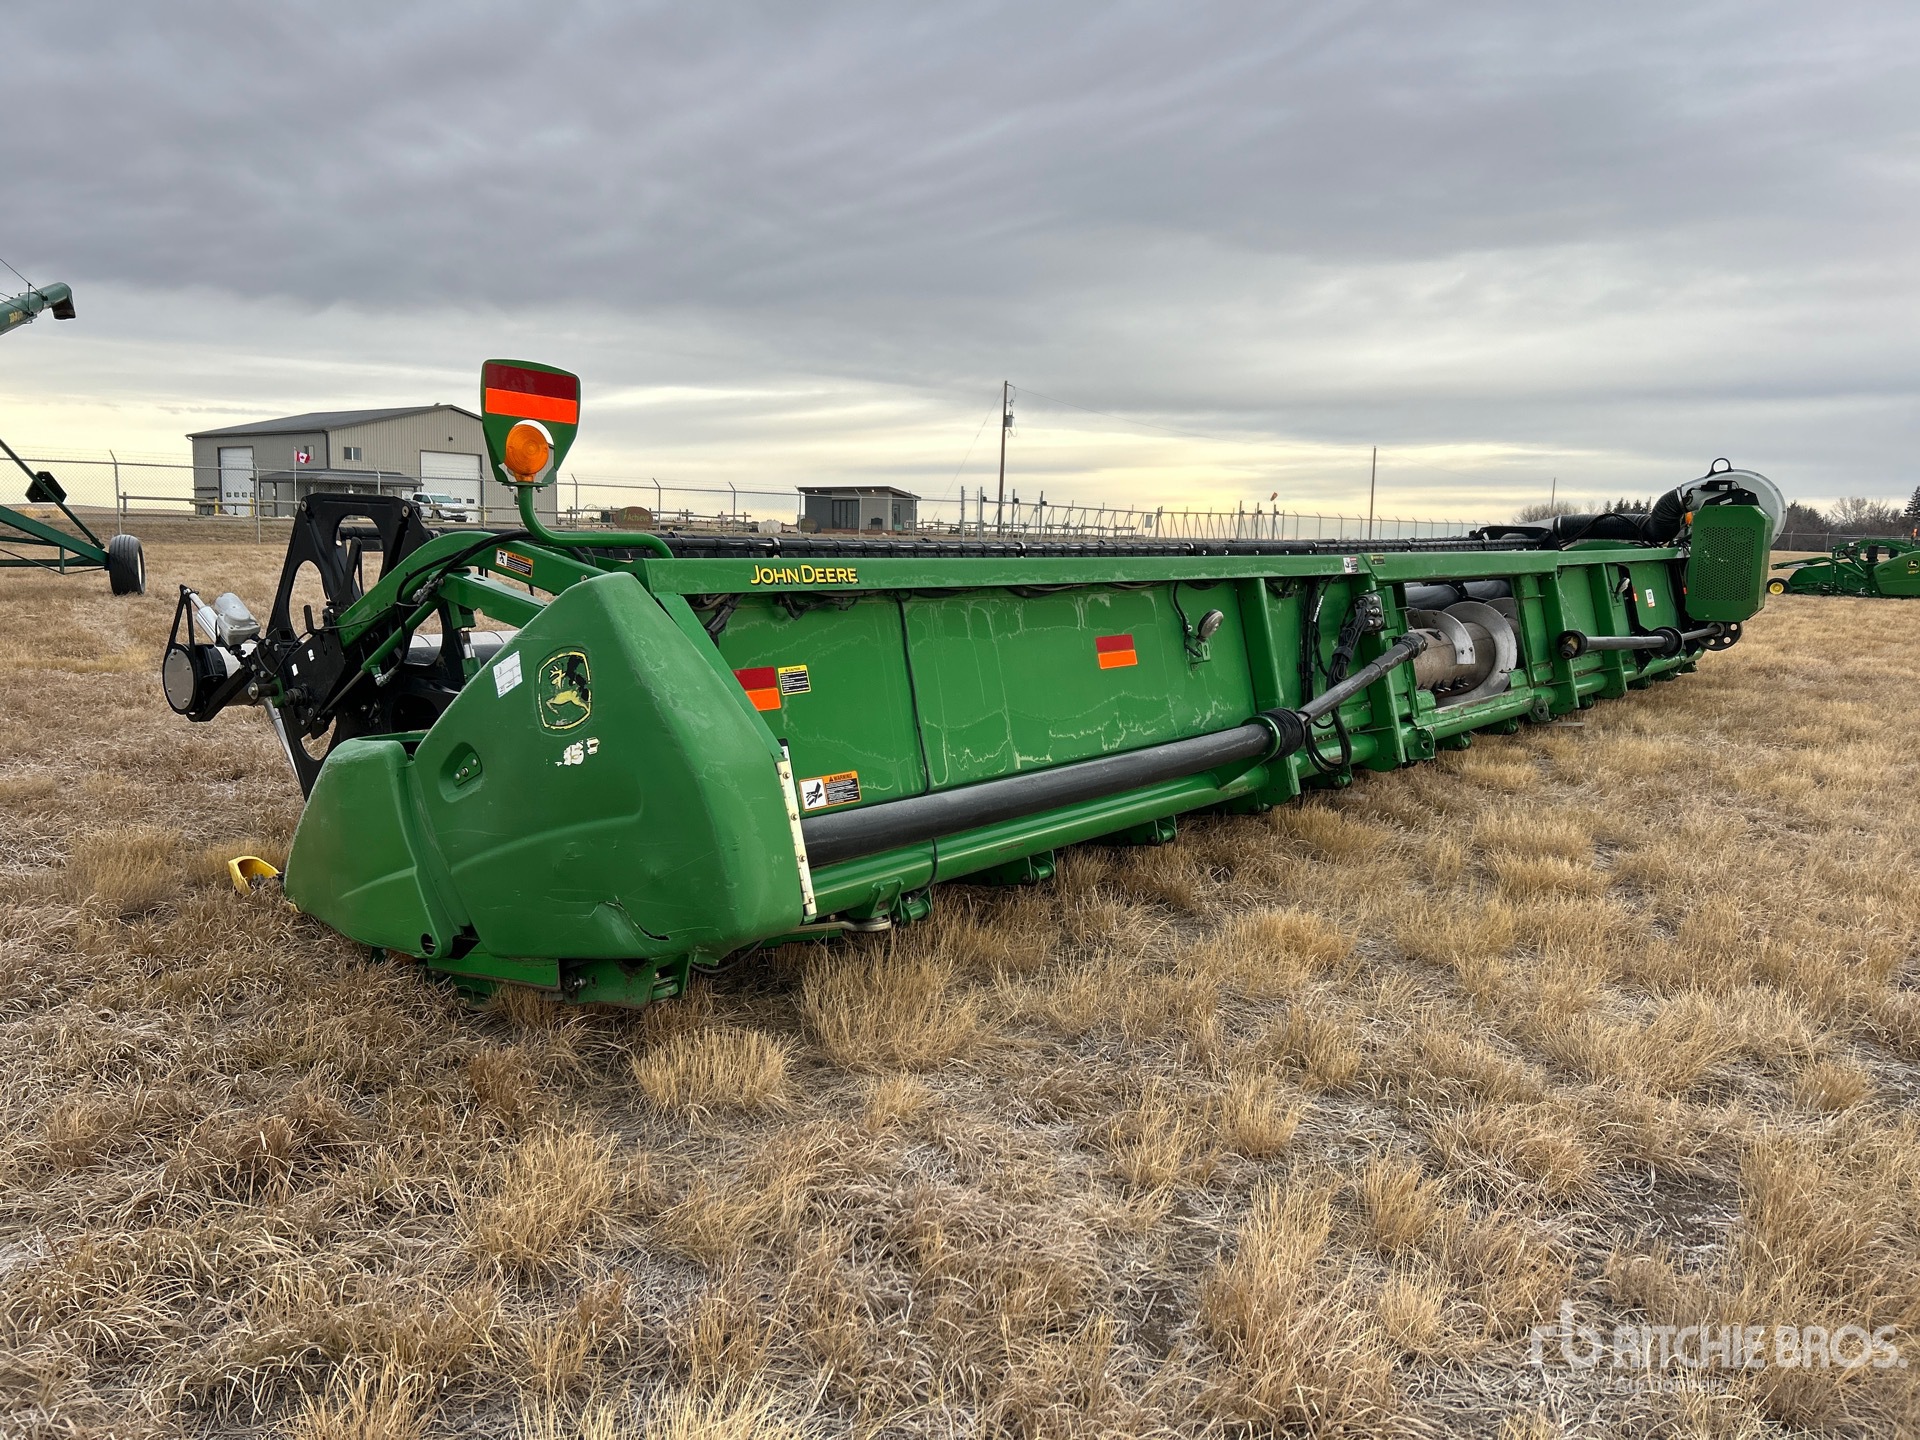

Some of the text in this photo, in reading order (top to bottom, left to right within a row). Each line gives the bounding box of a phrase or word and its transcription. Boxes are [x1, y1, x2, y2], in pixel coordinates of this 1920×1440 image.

[751, 565, 858, 584] JOHN DEERE
[833, 773, 853, 781] WARNING
